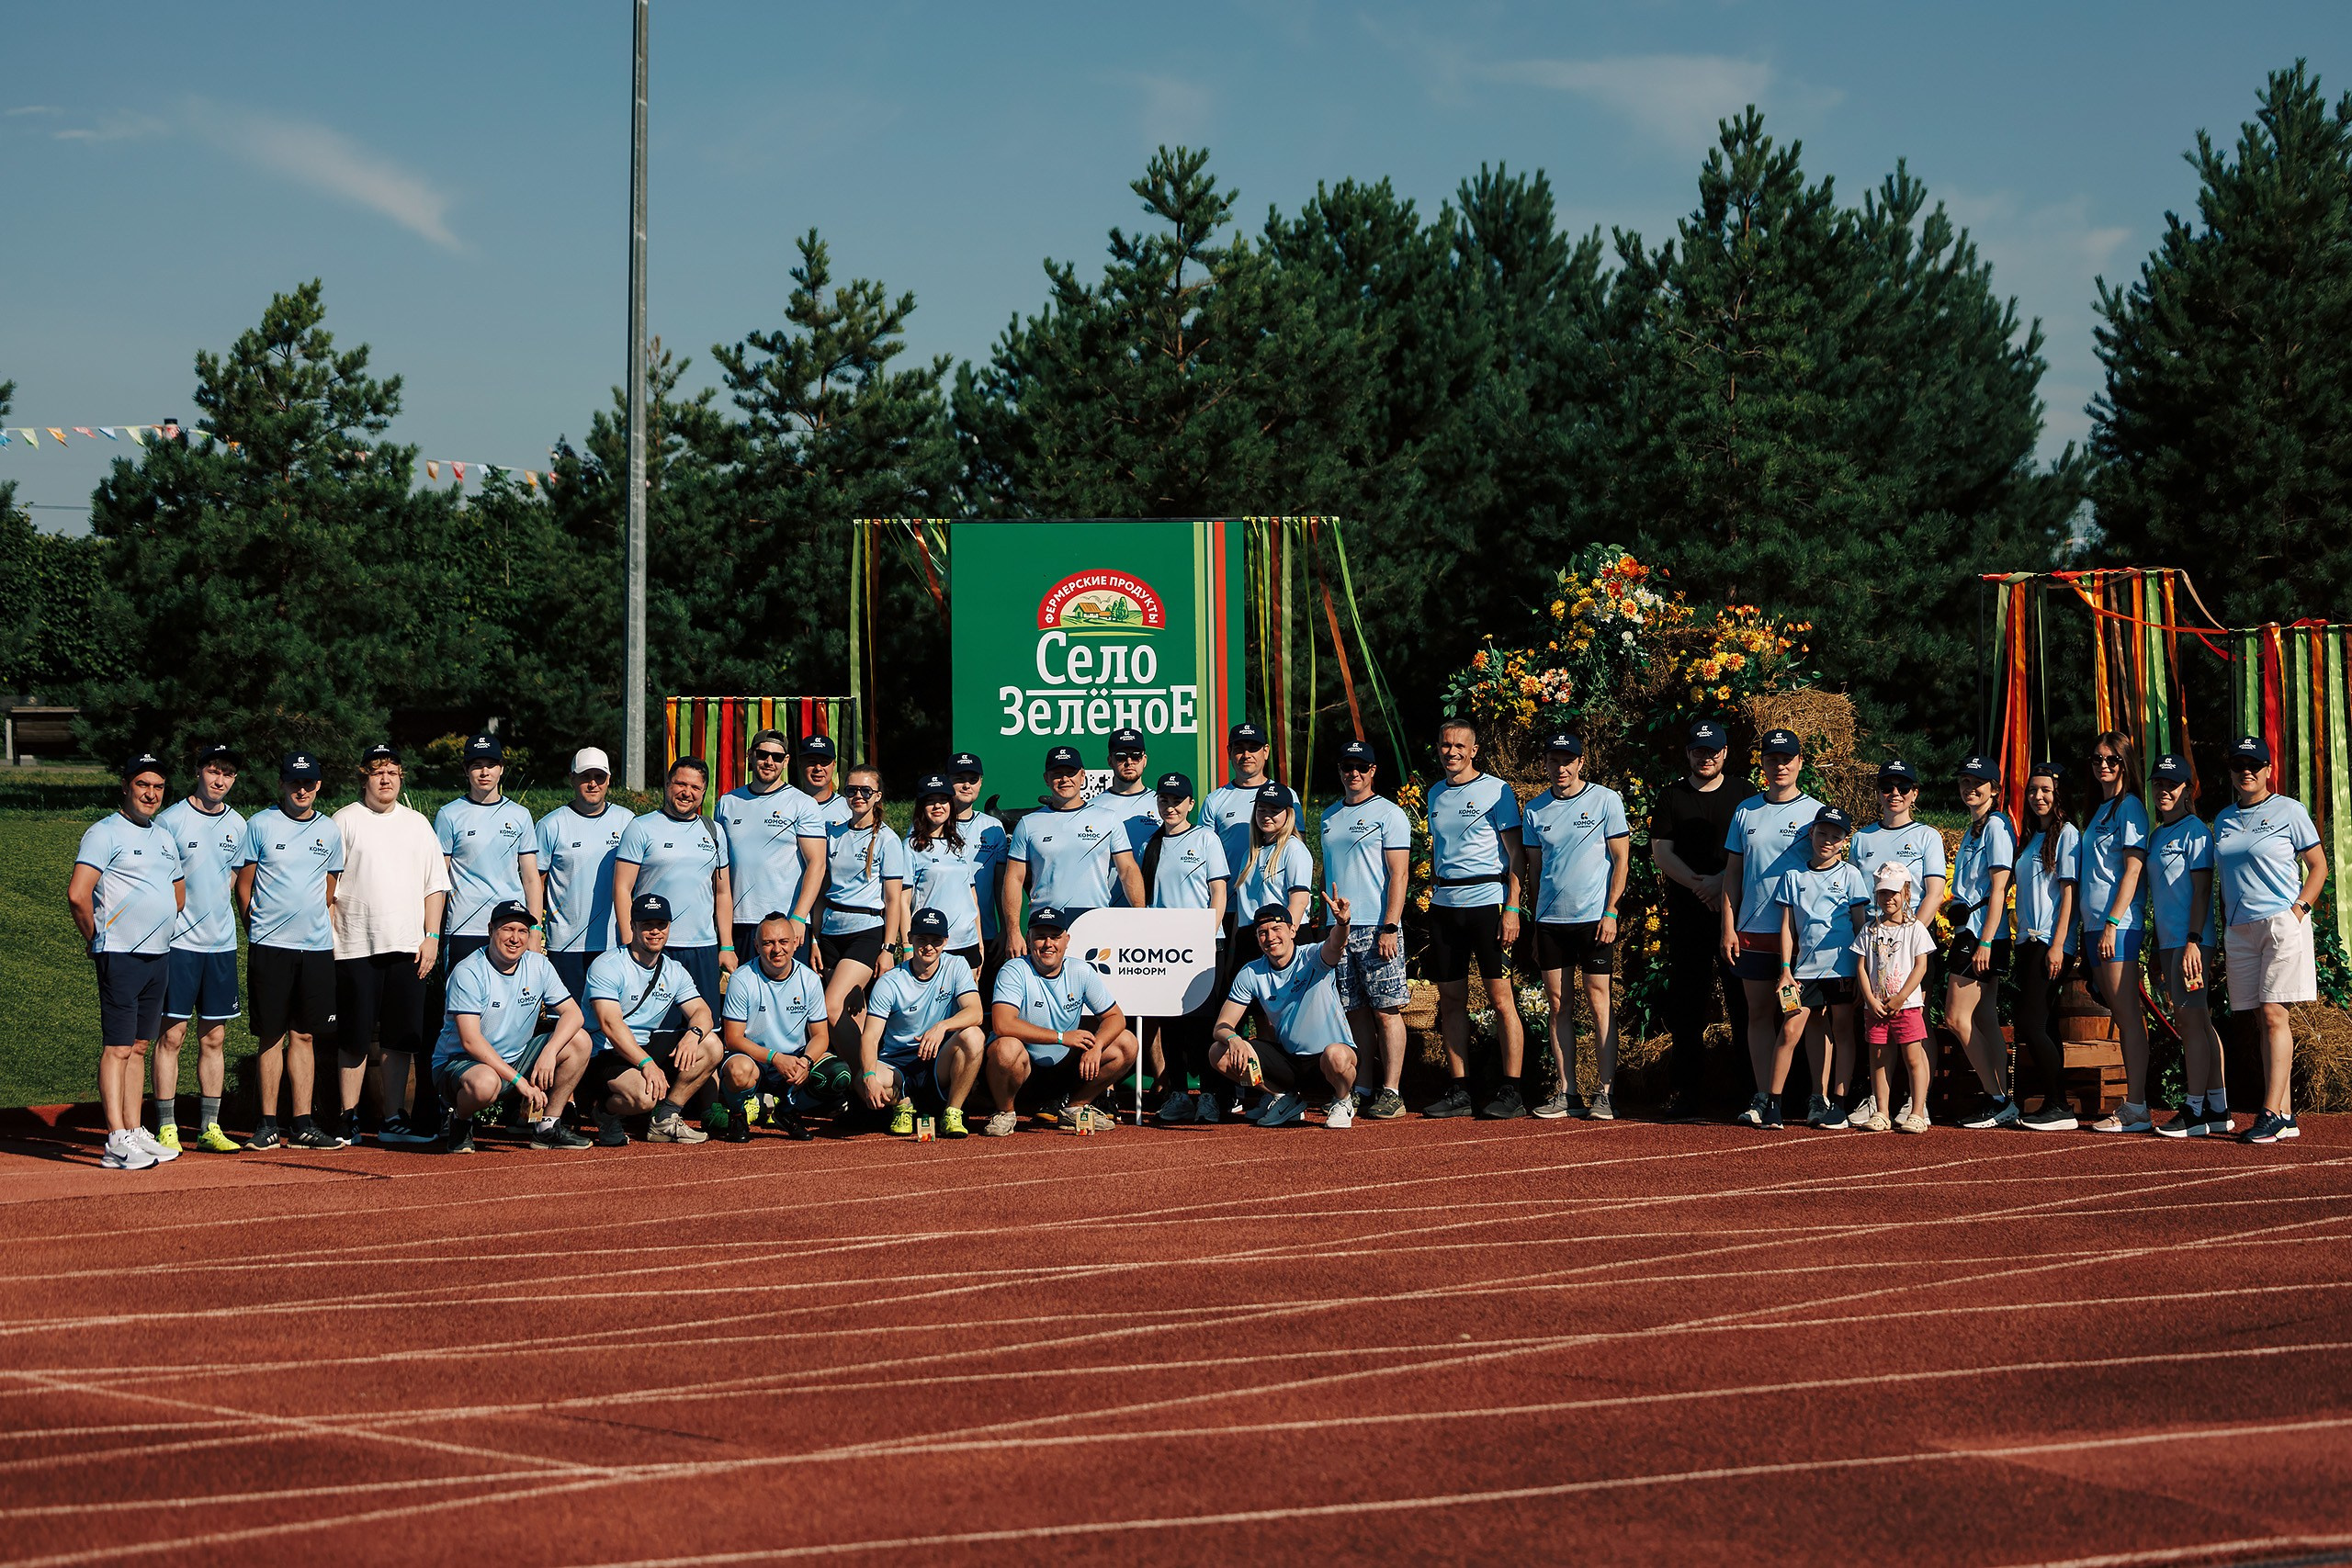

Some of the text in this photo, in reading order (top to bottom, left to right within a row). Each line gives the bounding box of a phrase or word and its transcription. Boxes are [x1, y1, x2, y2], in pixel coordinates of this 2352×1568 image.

[1045, 575, 1159, 624] ФЕРМЕРСКИЕ ПРОДУКТЫ
[1036, 631, 1157, 684] Село
[1118, 948, 1193, 963] КОМОС
